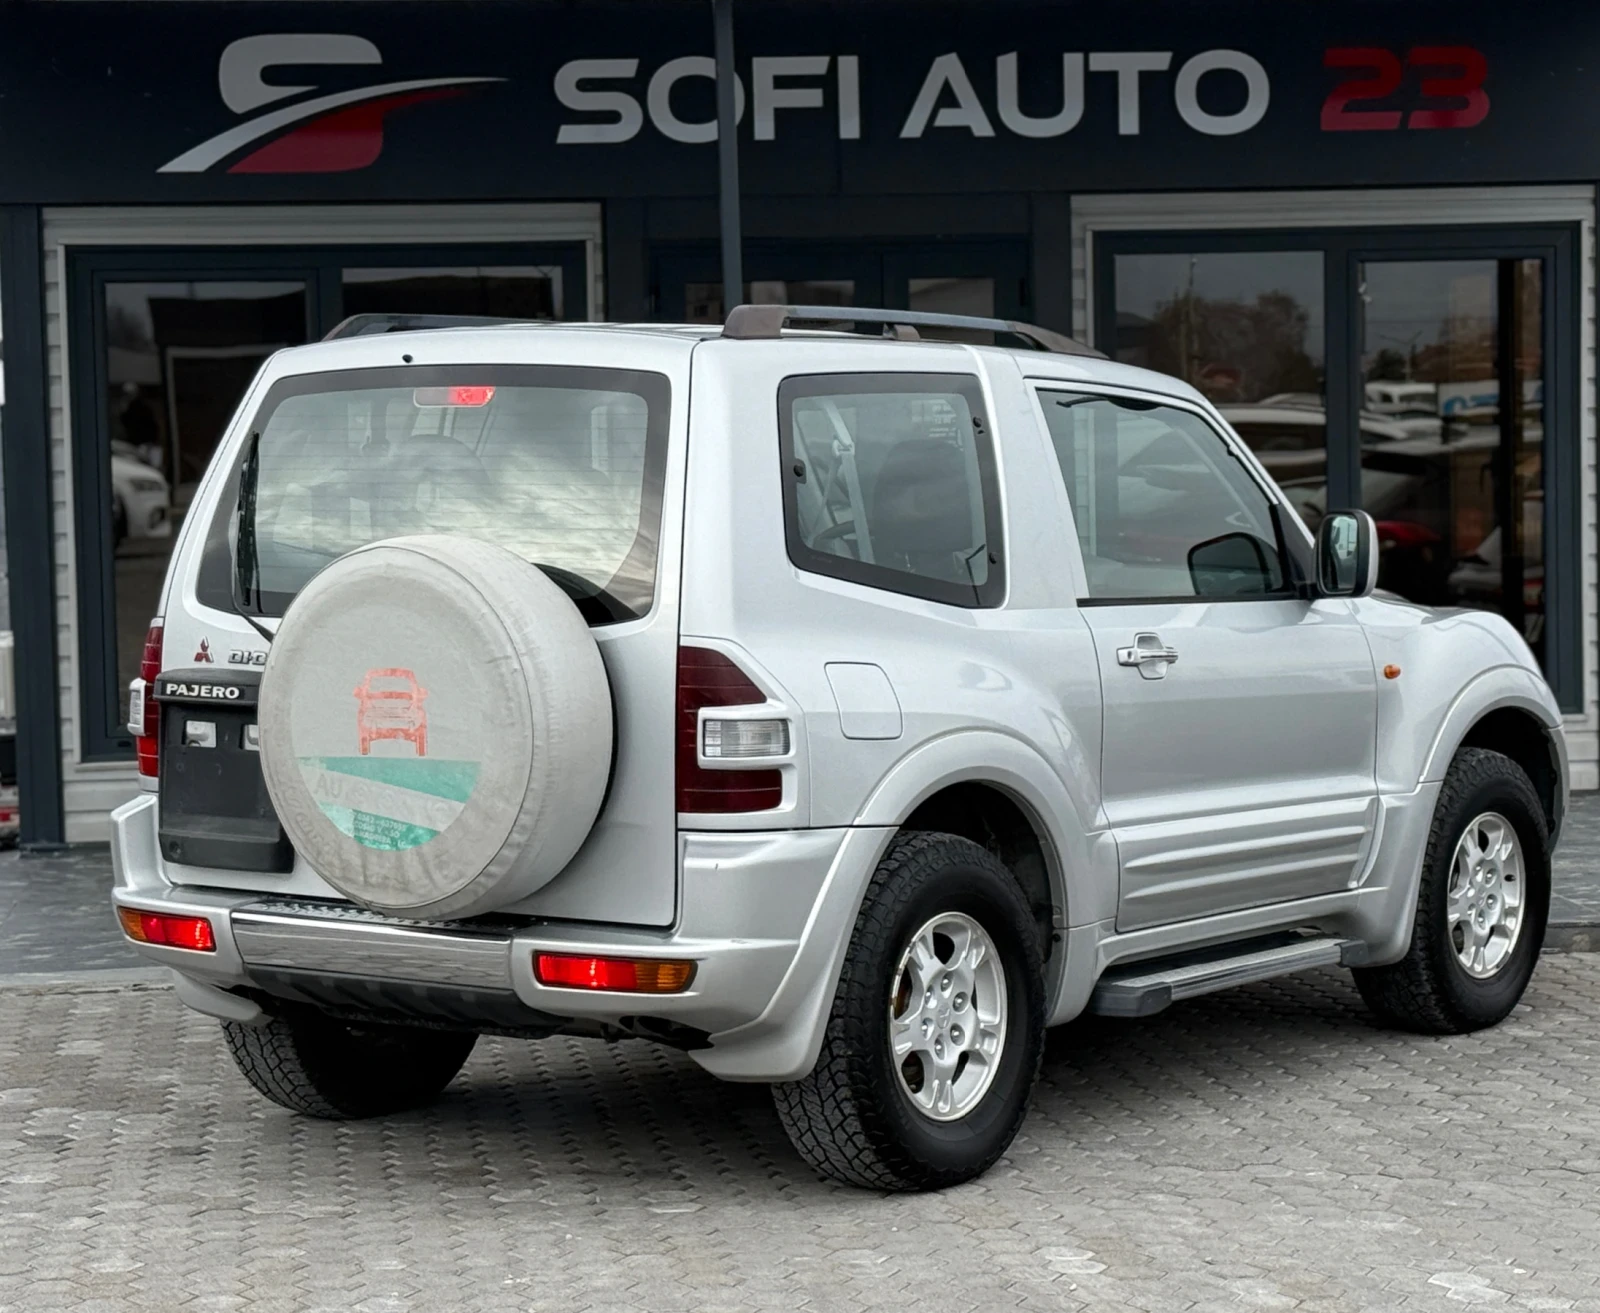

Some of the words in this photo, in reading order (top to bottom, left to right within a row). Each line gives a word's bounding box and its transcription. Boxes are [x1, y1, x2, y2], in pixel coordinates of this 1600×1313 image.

[554, 56, 861, 144] SOFI
[900, 49, 1270, 138] AUTO
[1320, 45, 1491, 131] 23
[165, 683, 240, 699] PAJERO
